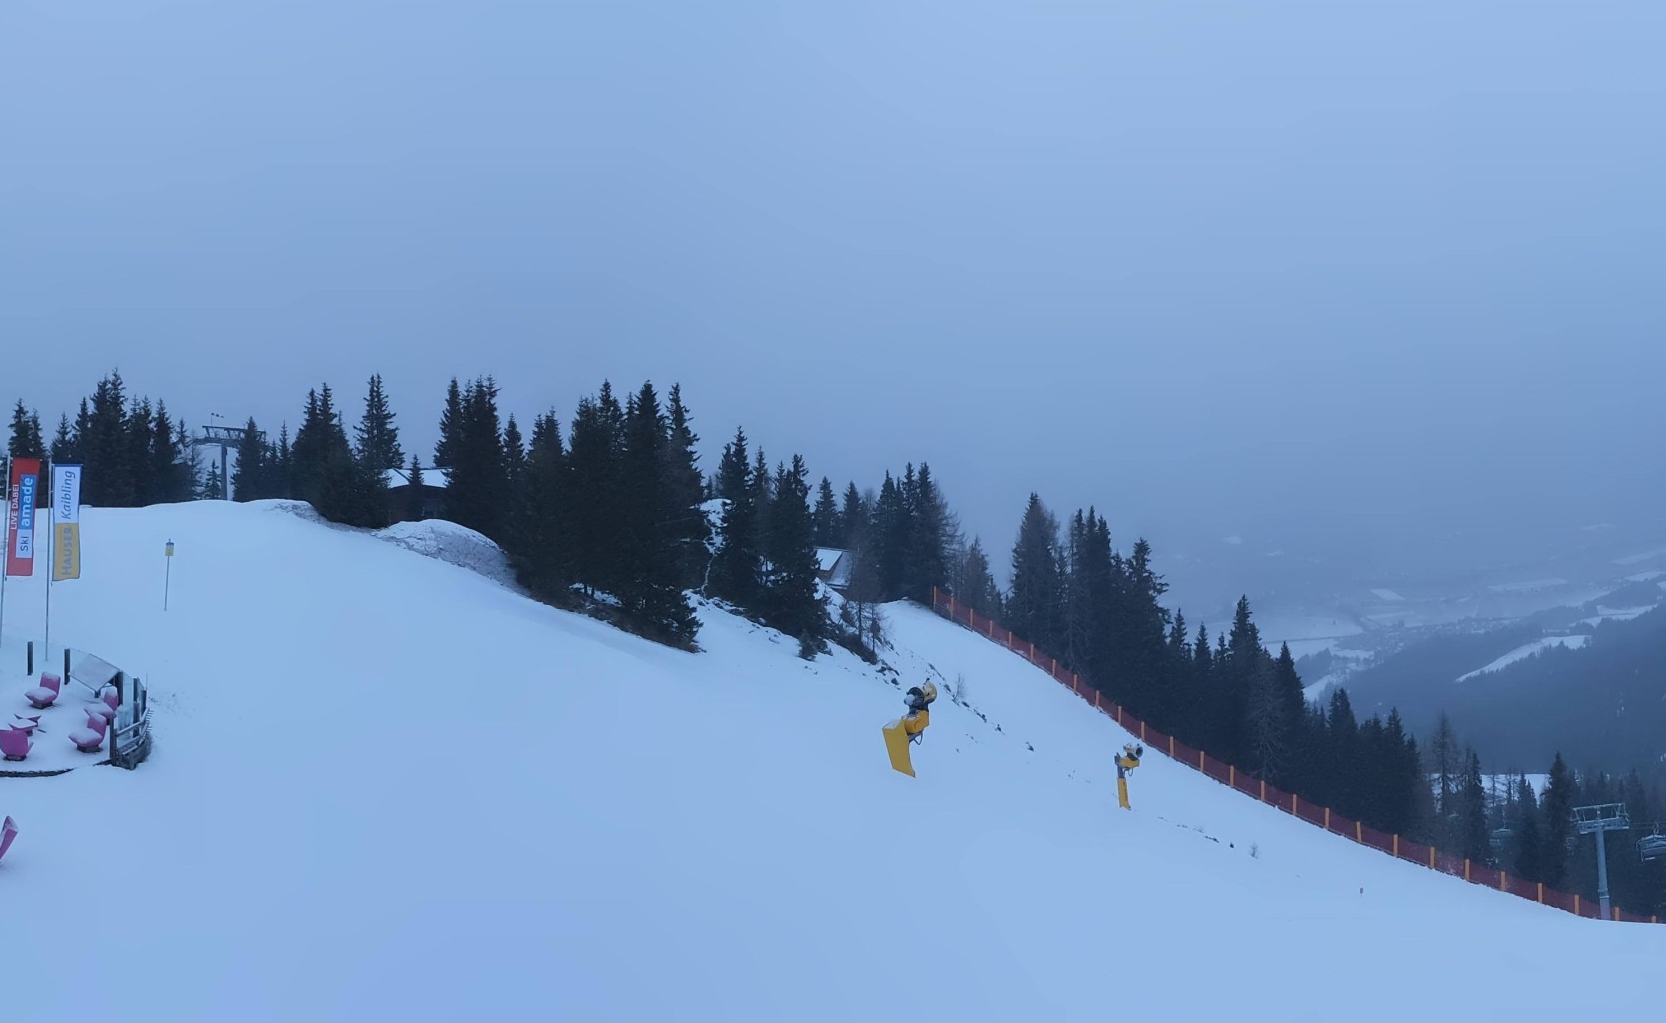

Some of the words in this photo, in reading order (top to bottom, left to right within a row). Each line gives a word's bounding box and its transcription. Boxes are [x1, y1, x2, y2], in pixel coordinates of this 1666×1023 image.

[12, 484, 20, 507] DABEI
[61, 470, 76, 520] Kaibling
[10, 508, 18, 530] LIVE
[61, 527, 74, 576] HAUSER
